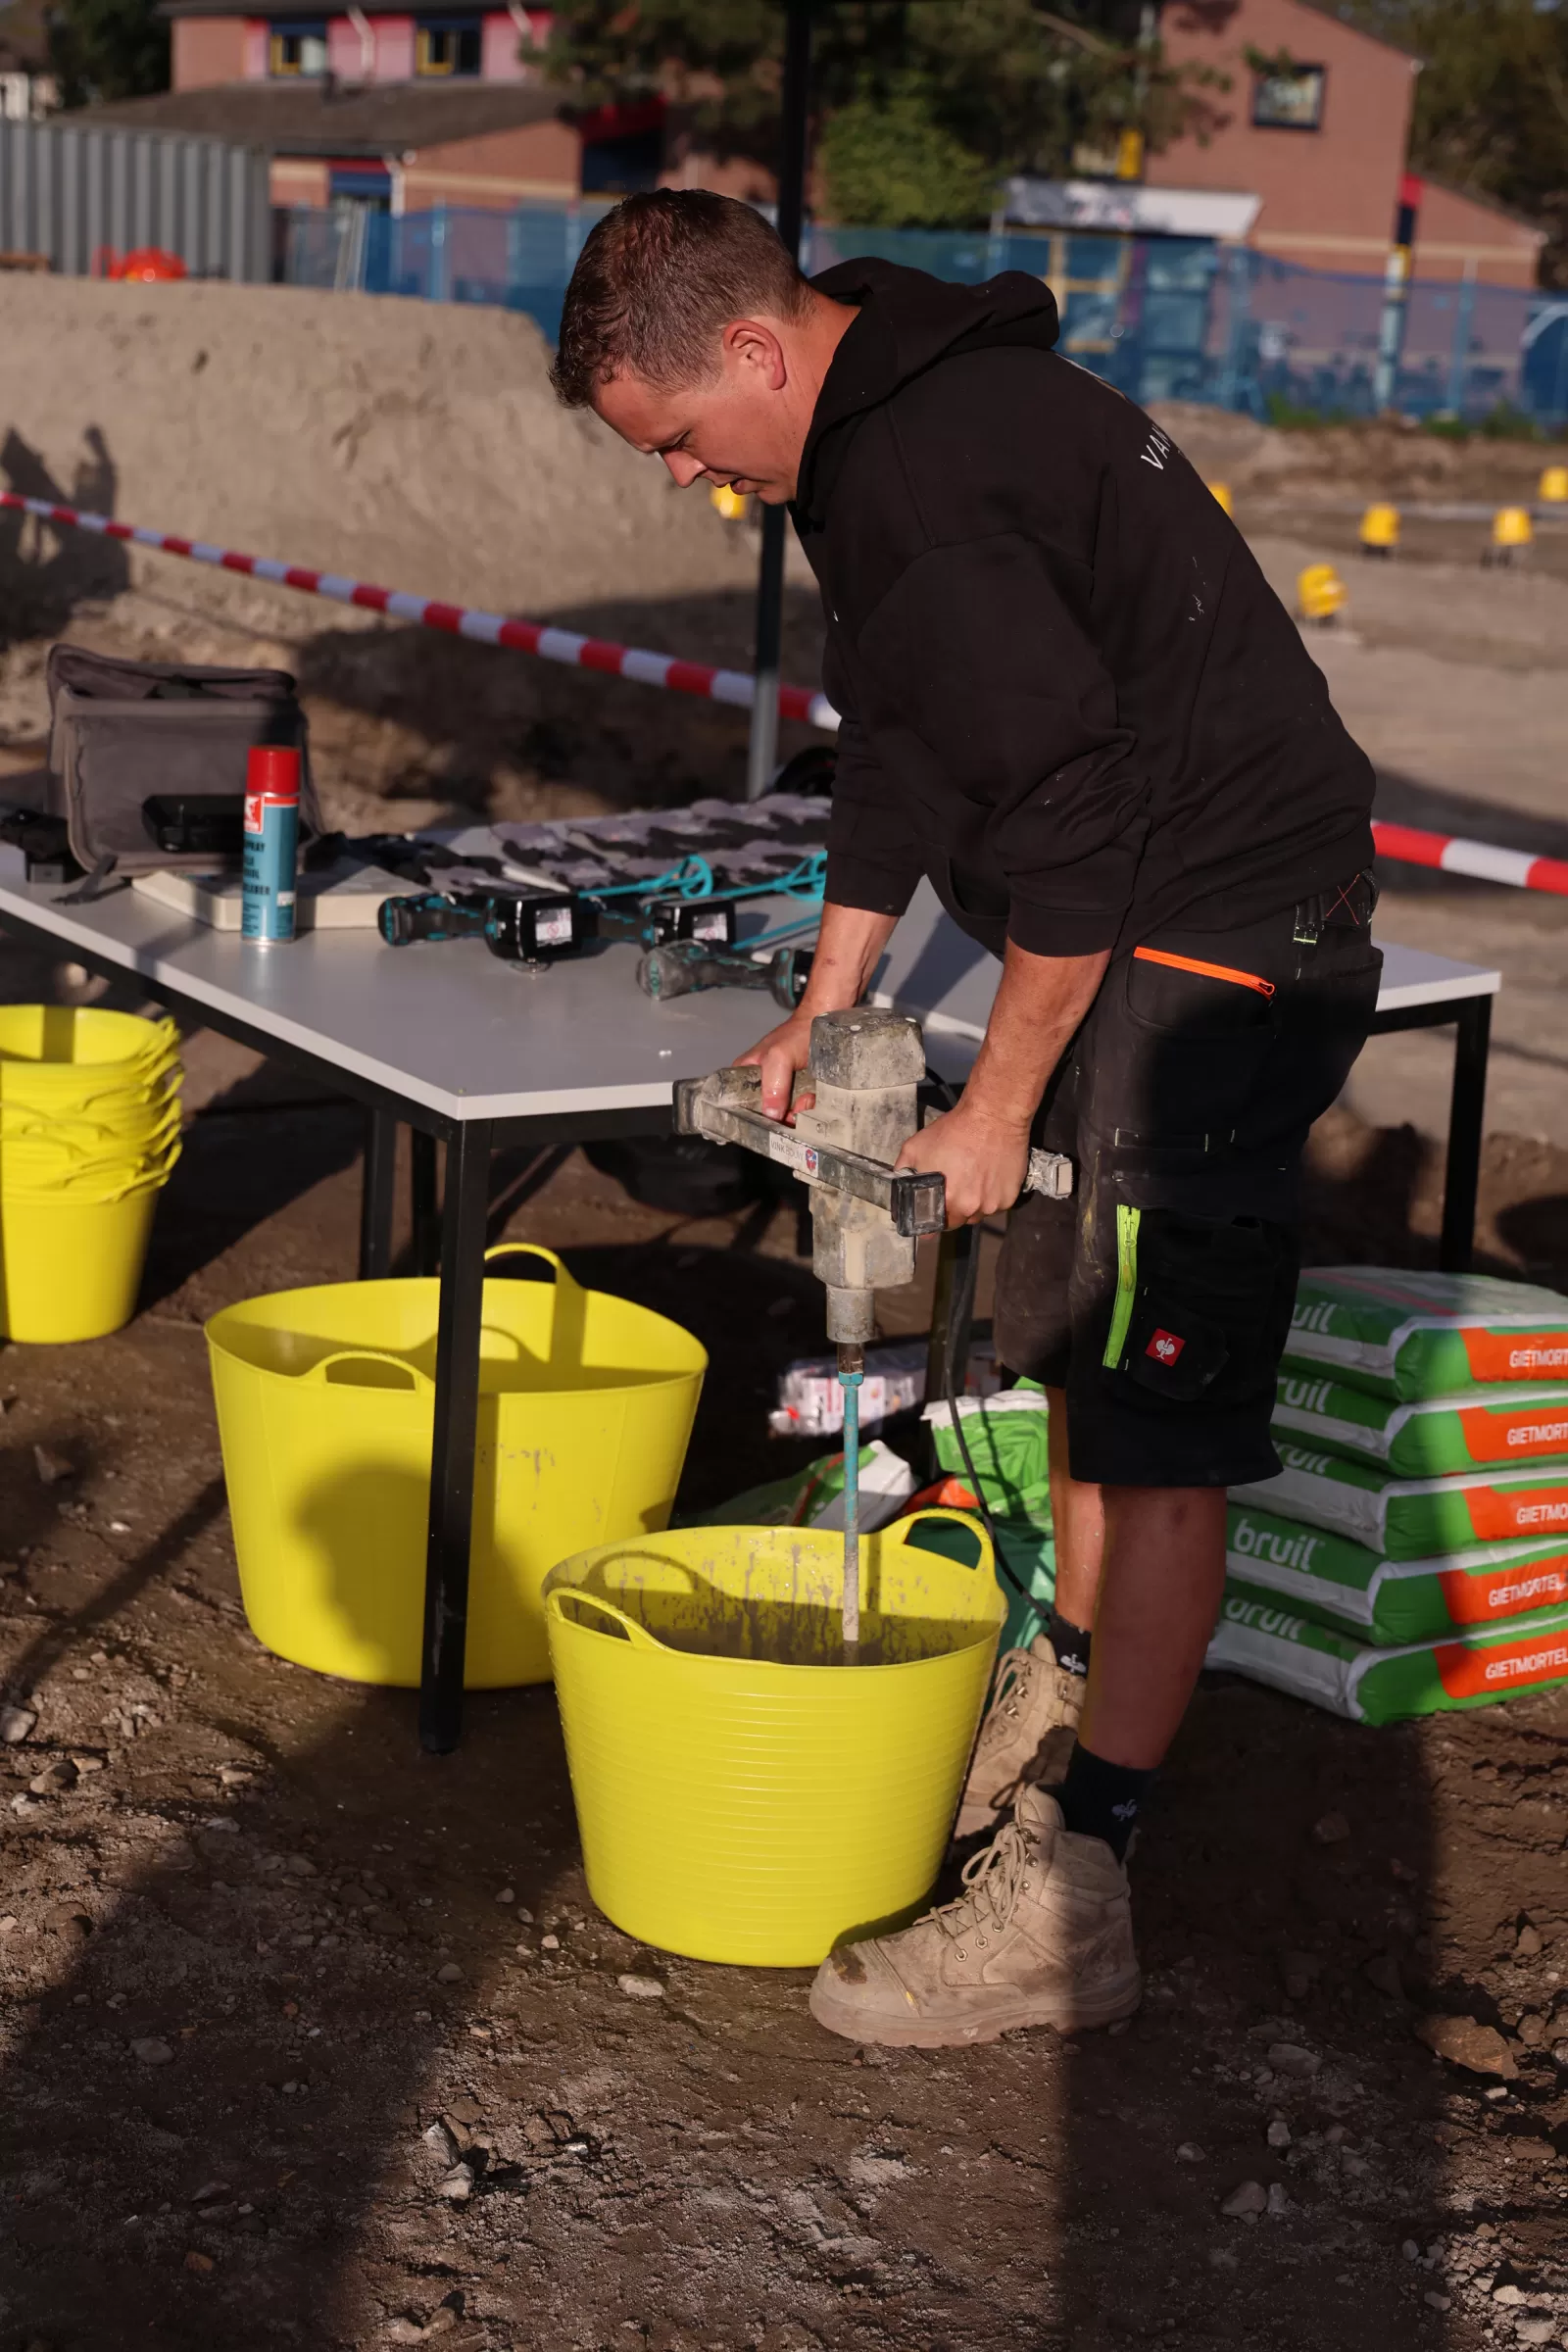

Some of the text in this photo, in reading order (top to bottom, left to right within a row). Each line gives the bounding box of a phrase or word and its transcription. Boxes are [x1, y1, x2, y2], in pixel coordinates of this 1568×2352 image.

[1233, 1517, 1319, 1572] bruil
[1488, 1571, 1567, 1607] GIETMORTEL
[1485, 1645, 1568, 1680] GIETMORTEL
